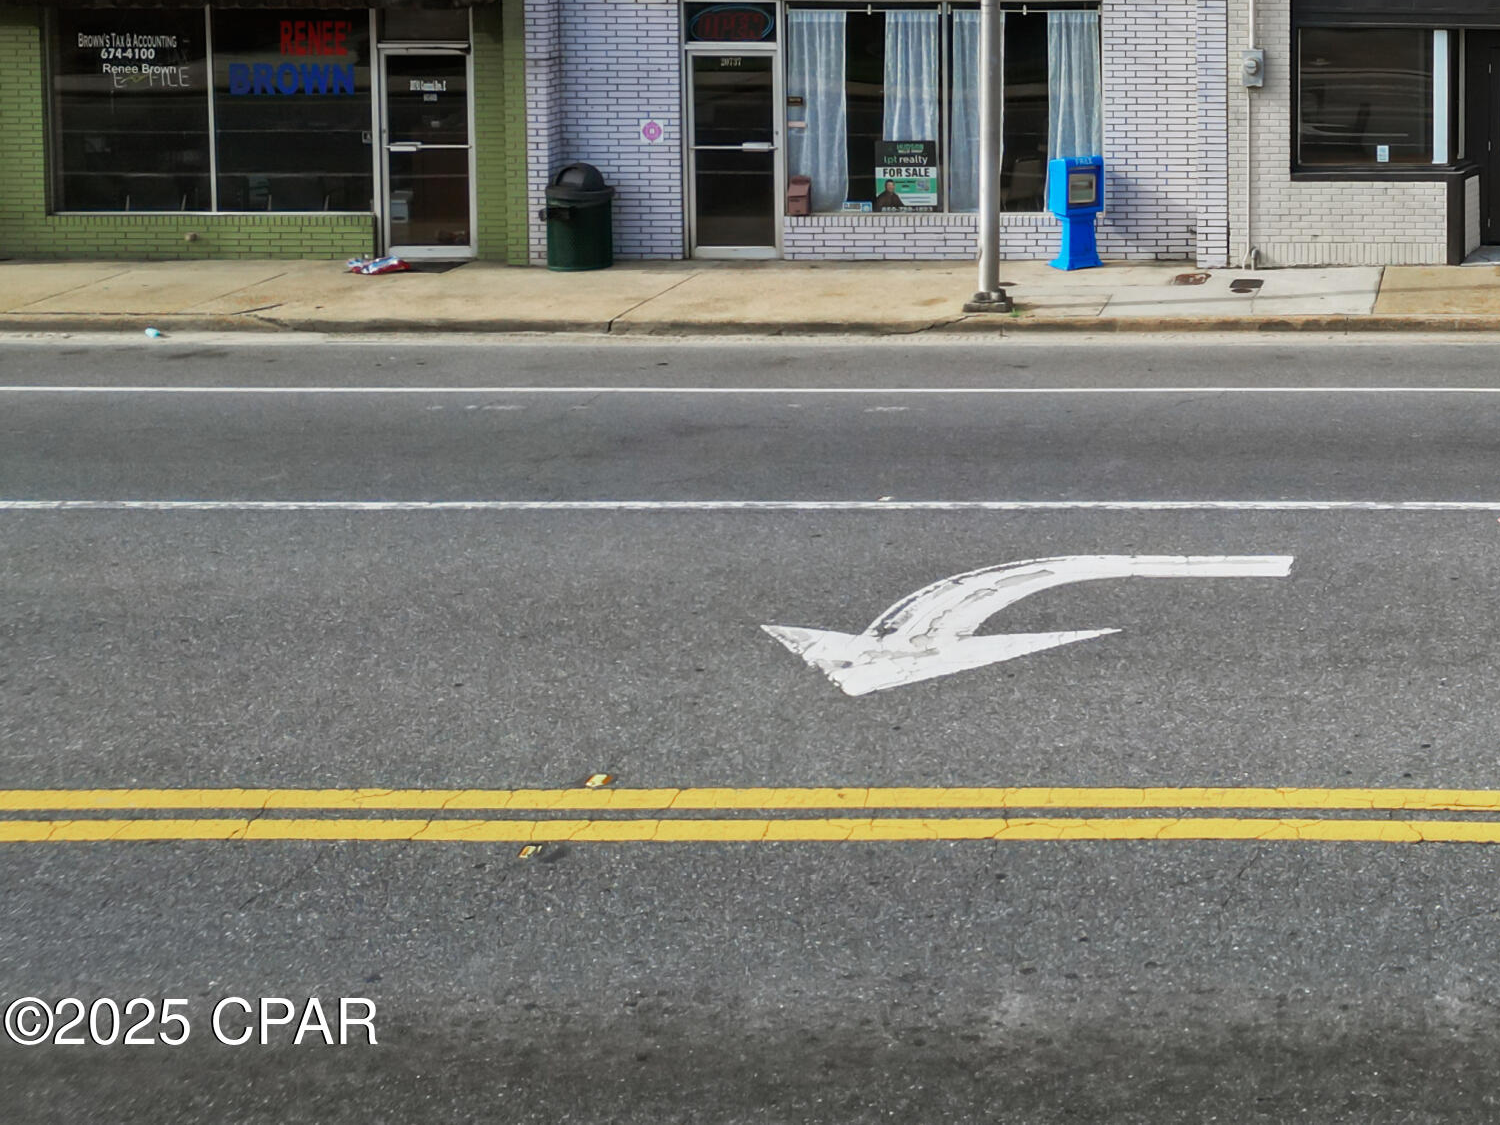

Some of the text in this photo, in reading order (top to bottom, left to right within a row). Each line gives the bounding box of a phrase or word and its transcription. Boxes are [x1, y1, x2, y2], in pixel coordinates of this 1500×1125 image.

[126, 33, 132, 47] &
[133, 33, 177, 47] ACCOUNTING
[101, 48, 155, 59] 674-4100
[103, 63, 177, 74] Renee Brown
[229, 63, 354, 95] BROWN
[899, 155, 928, 165] realty
[883, 168, 930, 177] FOR SALE
